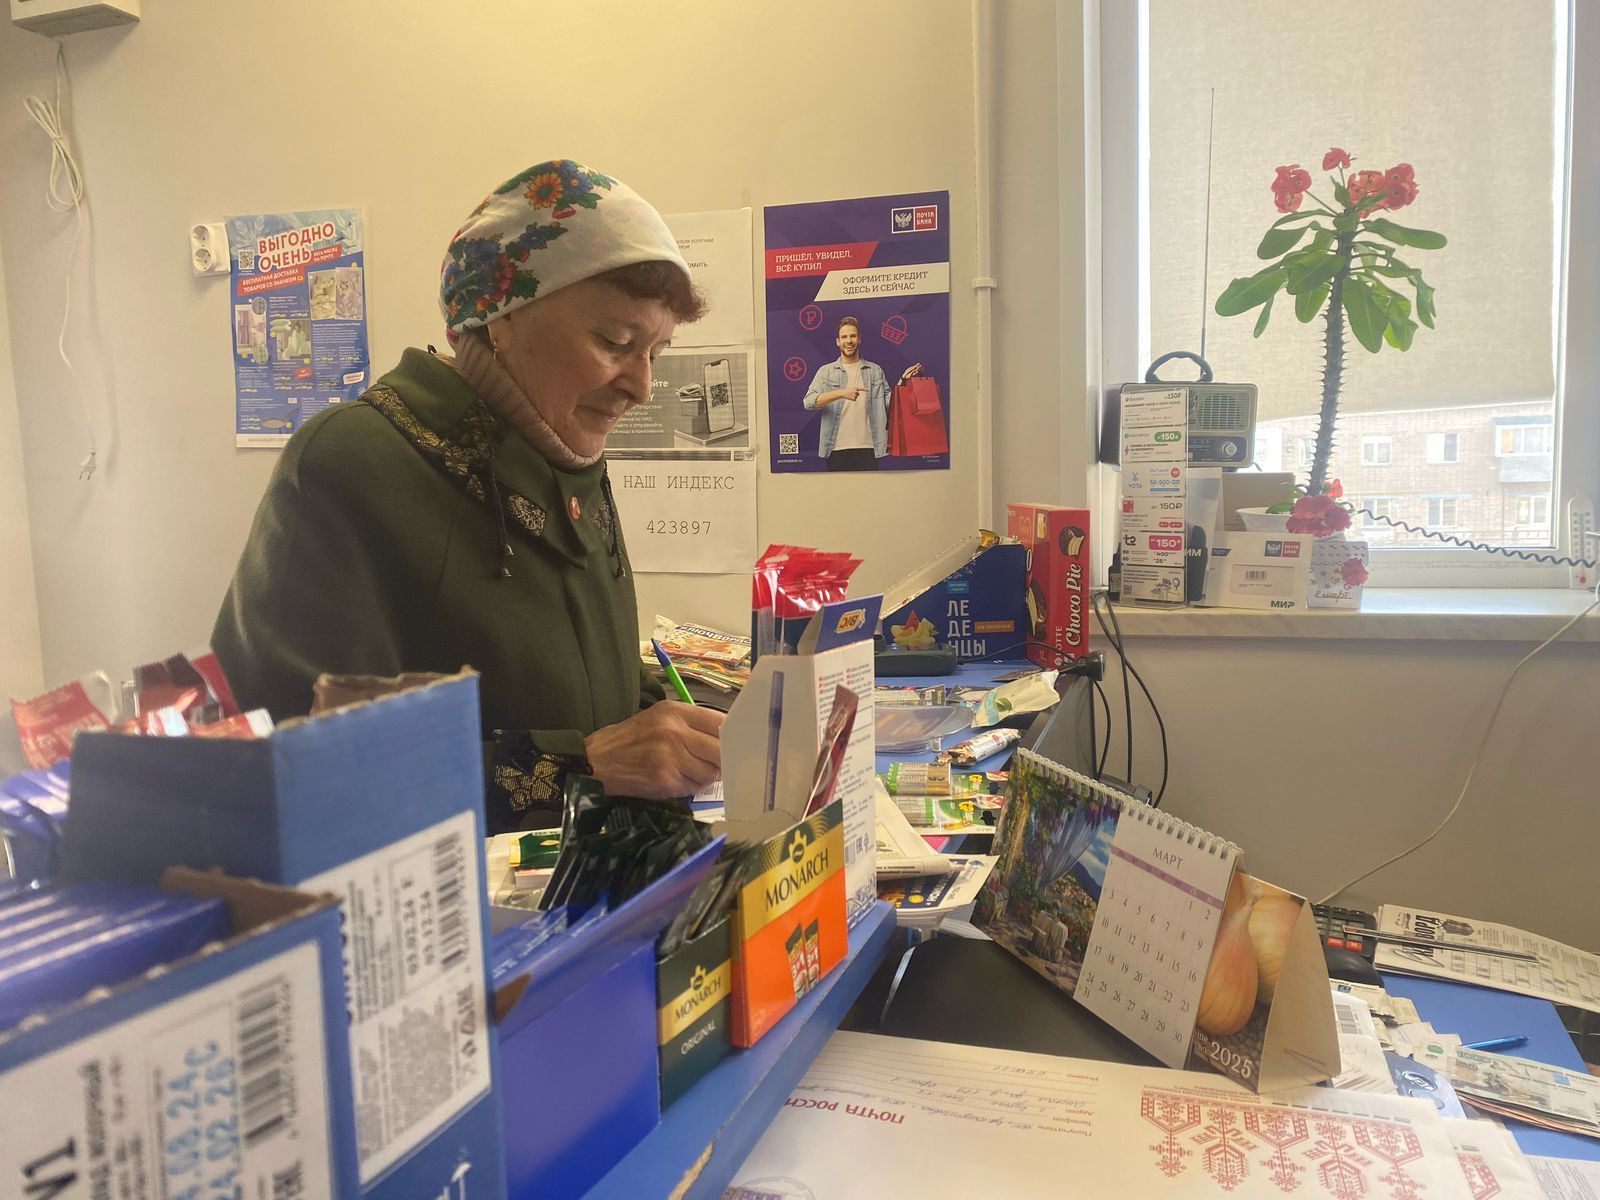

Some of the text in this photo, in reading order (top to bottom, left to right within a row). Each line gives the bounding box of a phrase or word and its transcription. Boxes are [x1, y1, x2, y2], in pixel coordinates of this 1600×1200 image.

[916, 211, 935, 219] ПОЧТА
[916, 218, 933, 226] БАНК
[259, 223, 334, 254] ВЫГОДНО
[259, 248, 310, 271] ОЧЕНЬ
[793, 262, 822, 272] КУПИЛ
[274, 268, 299, 279] ДОСТАВКА
[842, 271, 928, 285] ОФОРМИТЕ КРЕДИТ
[243, 283, 265, 293] ТОВАРОВ
[843, 285, 871, 295] ЗДЕСЬ
[880, 282, 916, 291] СЕЙЧАС
[623, 475, 735, 492] НАШ ИНДЕКС
[646, 519, 712, 535] 423897
[1123, 533, 1137, 546] t2
[947, 600, 970, 616] ЛЕ
[1065, 563, 1082, 646] Choco Pie
[1270, 600, 1296, 608] МИР
[838, 613, 861, 629] BIC
[947, 619, 971, 638] ДЕ
[1152, 847, 1183, 870] МАРТ
[765, 848, 829, 913] MONARCH
[1188, 901, 1211, 920] 1 2
[1122, 898, 1128, 907] 4
[1136, 905, 1142, 915] 5
[1150, 914, 1156, 924] 6
[1165, 922, 1170, 932] 7
[1180, 931, 1186, 941] 8
[1197, 939, 1203, 950] 9
[1102, 917, 1197, 982] 10 11 12 13 14 15 16
[1094, 945, 1190, 1012] 17 18 19 20 21 22 23
[674, 975, 721, 1024] MONARCH
[1082, 987, 1091, 999] 31
[1086, 972, 1095, 984] 24
[1099, 981, 1107, 993] 25
[1112, 990, 1121, 1002] 26
[1126, 999, 1136, 1012] 27
[1140, 1009, 1150, 1022] 28
[1156, 1020, 1165, 1033] 29
[1172, 1030, 1183, 1044] 30
[680, 1020, 717, 1055] ORIGINAL
[1209, 1041, 1253, 1079] 2025
[783, 1098, 836, 1113] РОССИ
[845, 1104, 905, 1124] ПОЧТА
[1053, 1115, 1094, 1127] Телефон
[1037, 1125, 1093, 1138] Получатель
